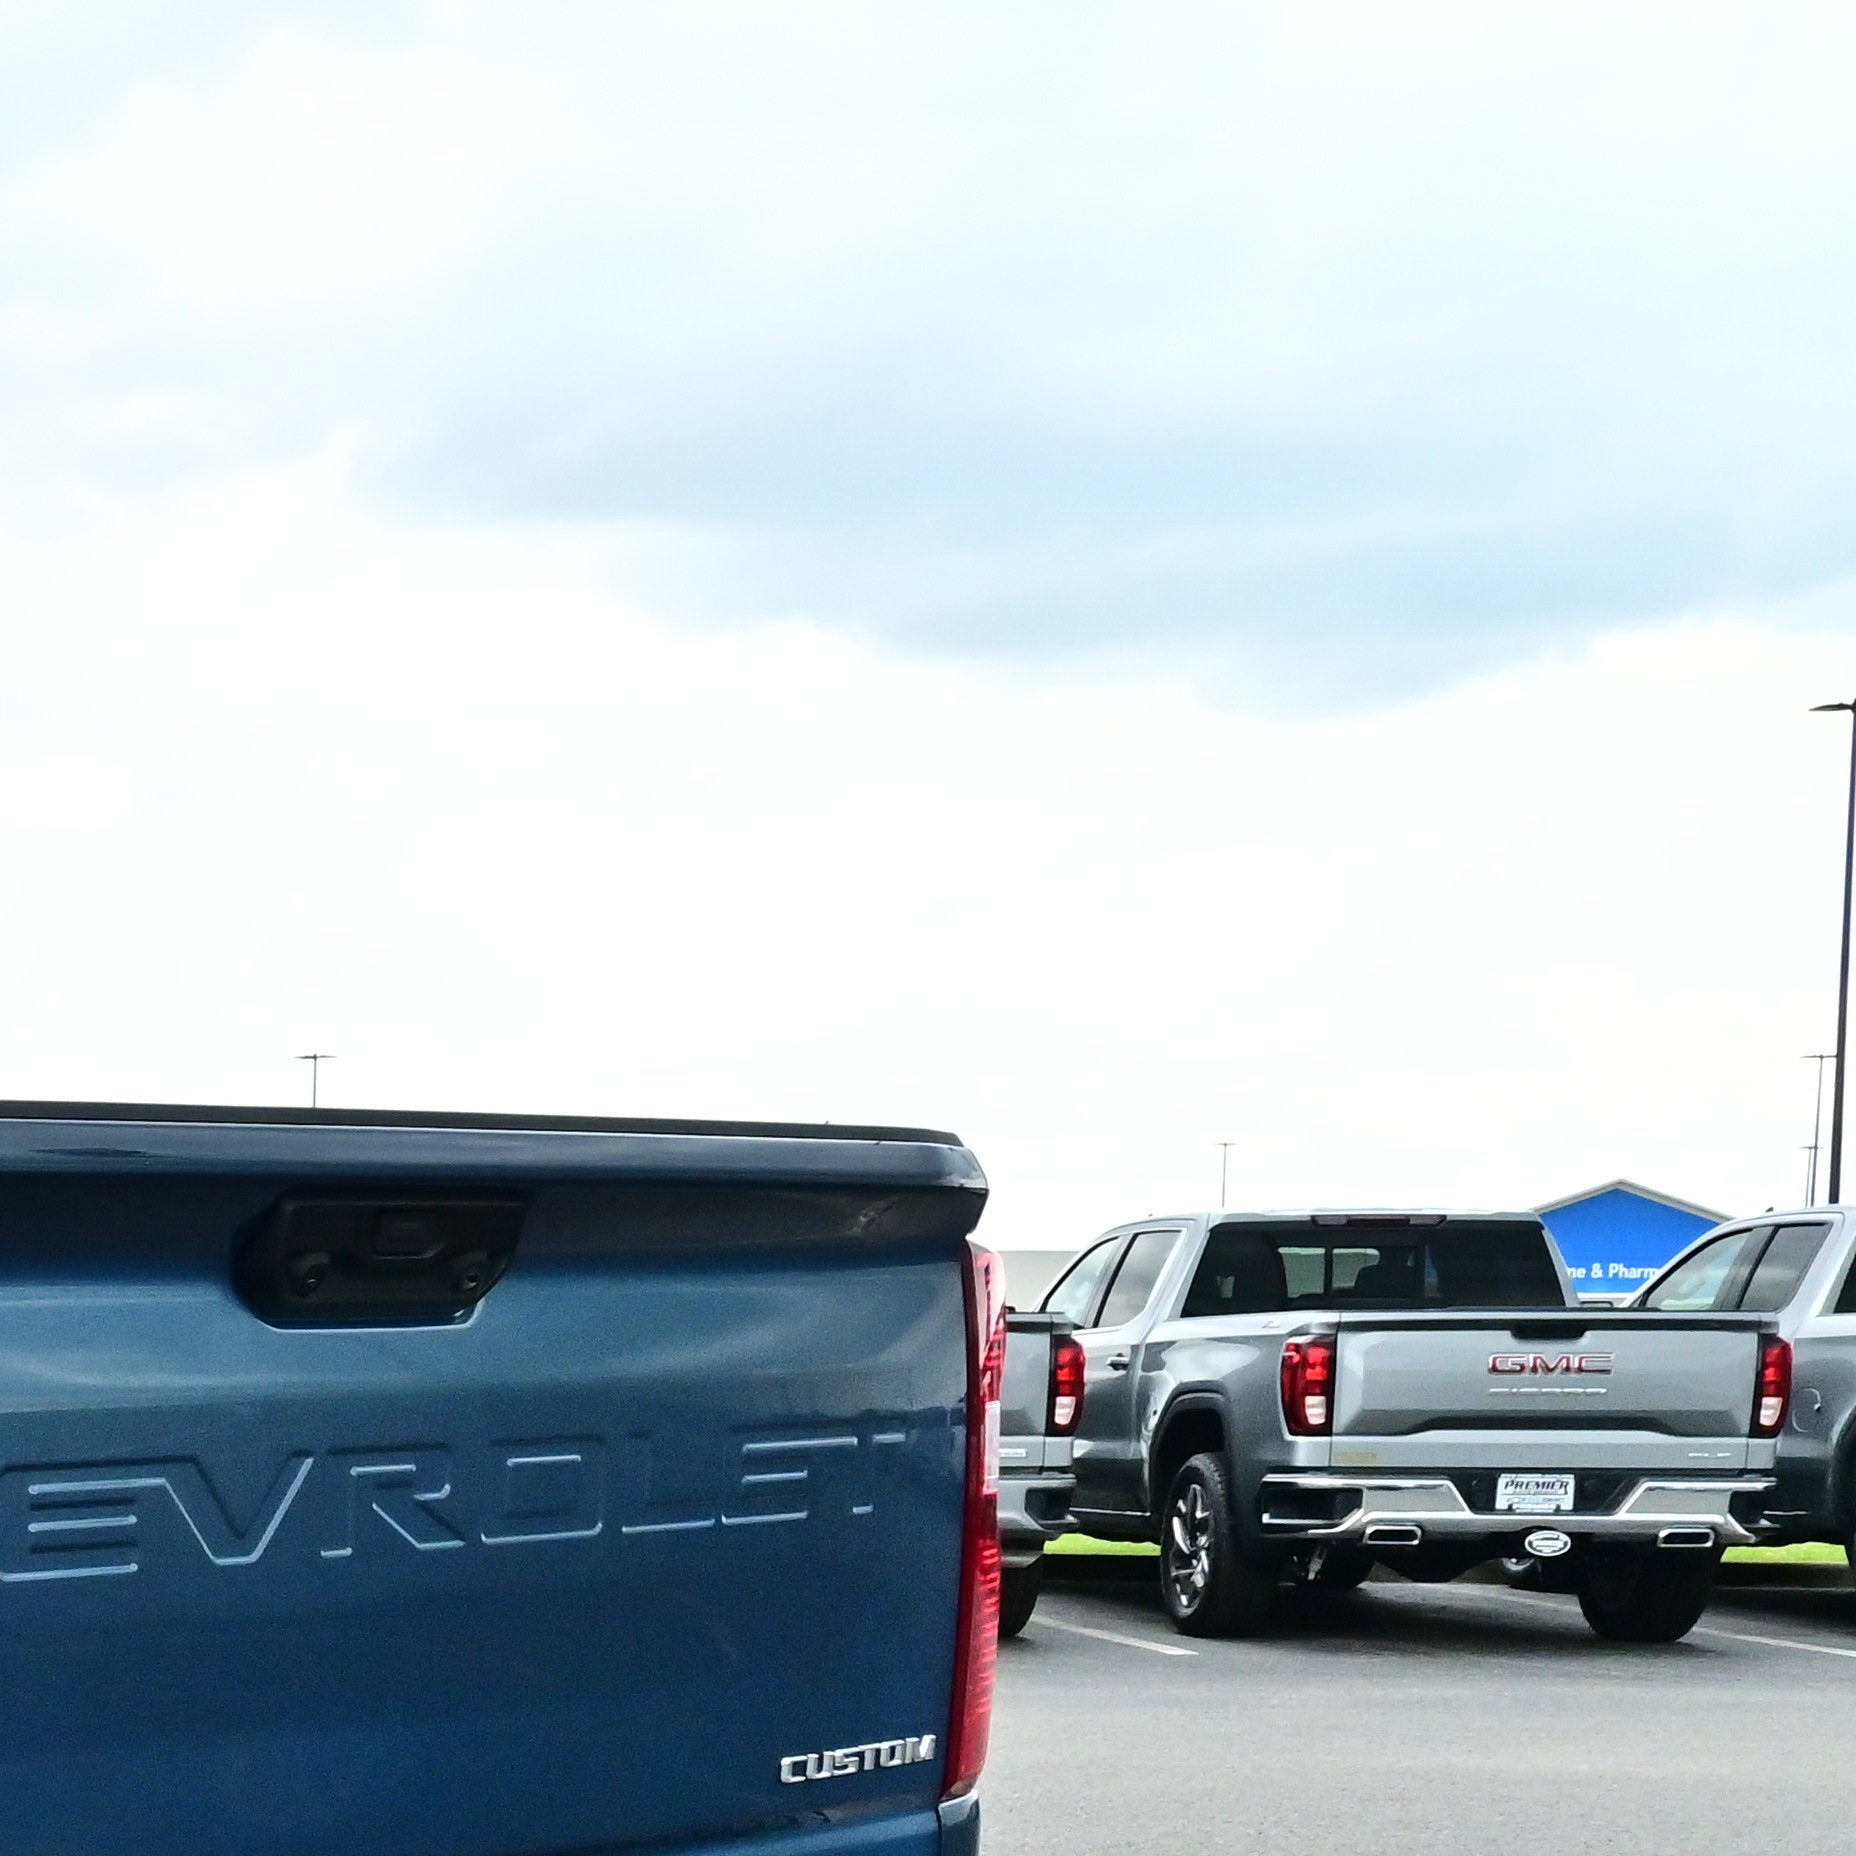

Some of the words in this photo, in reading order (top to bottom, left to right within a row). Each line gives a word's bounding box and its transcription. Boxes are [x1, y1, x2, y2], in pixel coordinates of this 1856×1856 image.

[1591, 1262, 1603, 1279] &
[1608, 1262, 1660, 1279] Pharm
[1488, 1351, 1615, 1376] GMC
[780, 1734, 937, 1784] CUSTOM
